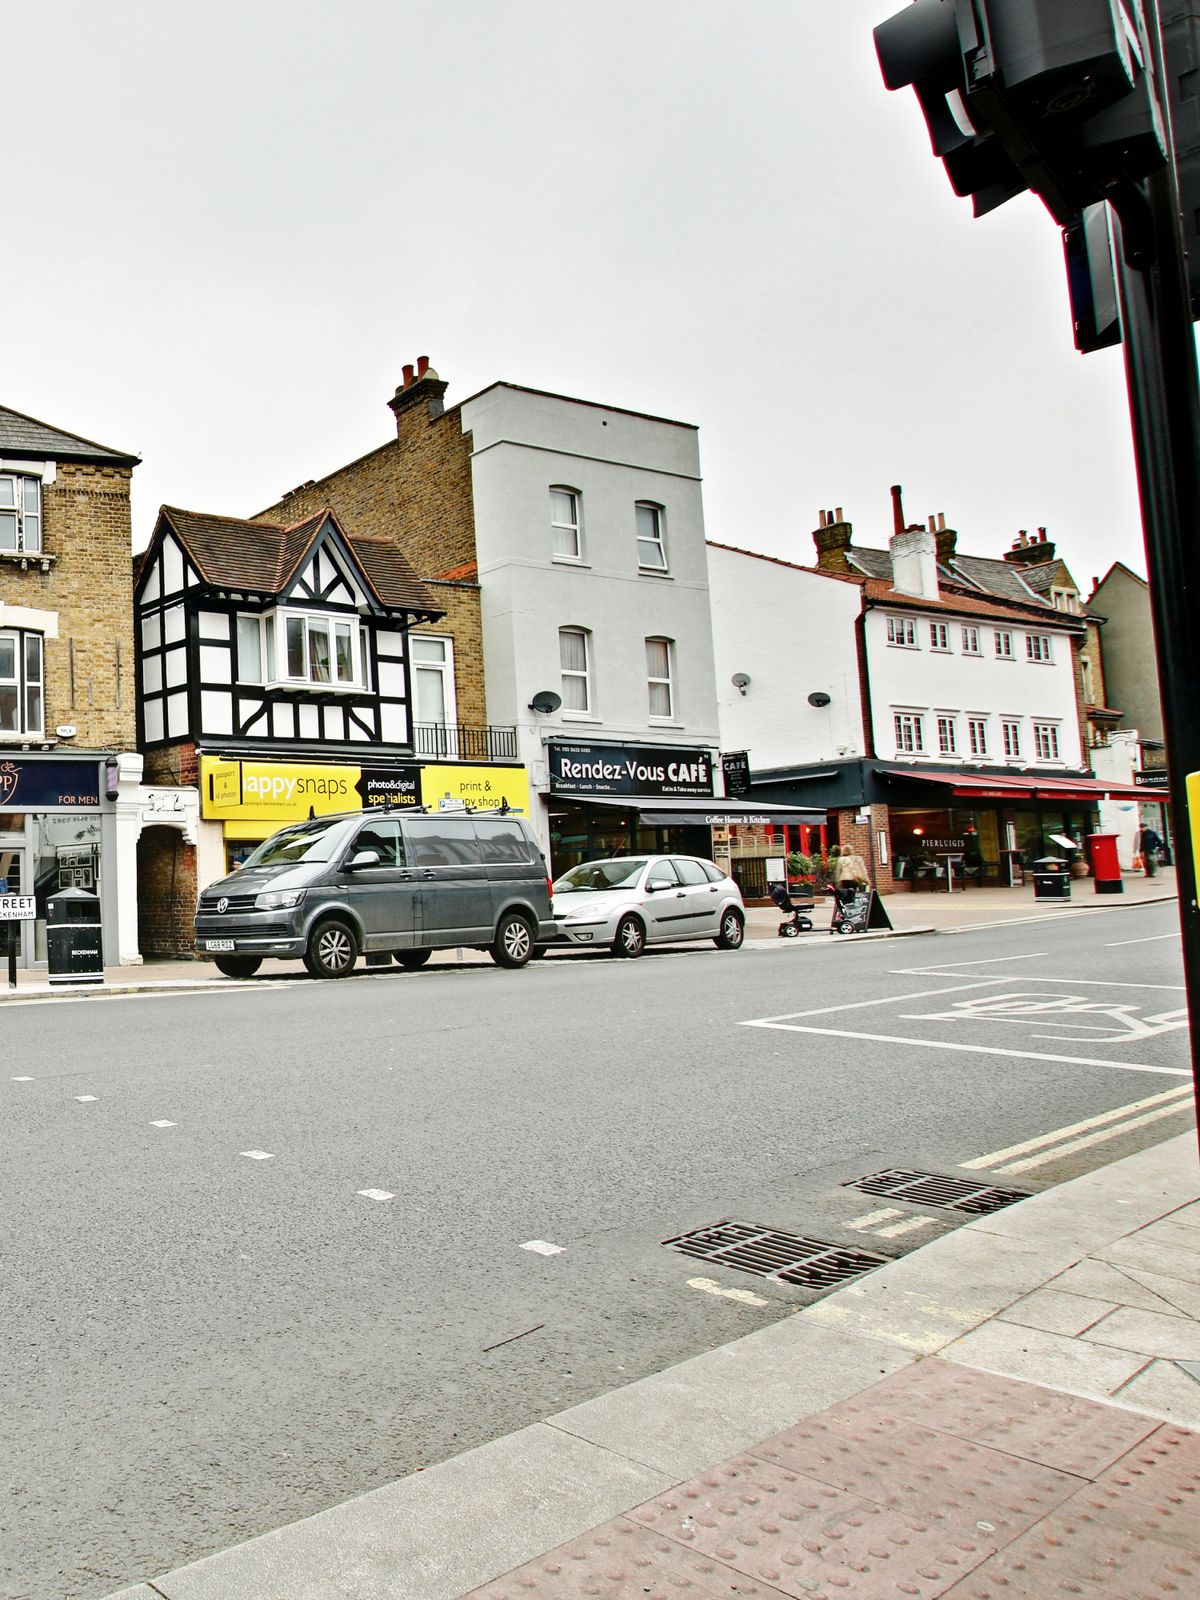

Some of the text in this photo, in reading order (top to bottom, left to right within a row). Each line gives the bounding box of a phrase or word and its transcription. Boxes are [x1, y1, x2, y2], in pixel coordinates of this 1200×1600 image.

[560, 758, 665, 781] Rendez-Vous
[667, 756, 708, 783] CAFÉ
[460, 780, 492, 793] print &
[58, 796, 98, 805] FOR MEN
[368, 794, 416, 805] speialists
[478, 796, 500, 807] shop
[705, 815, 724, 824] Coffee
[725, 815, 742, 824] House
[749, 815, 770, 824] Kitchen
